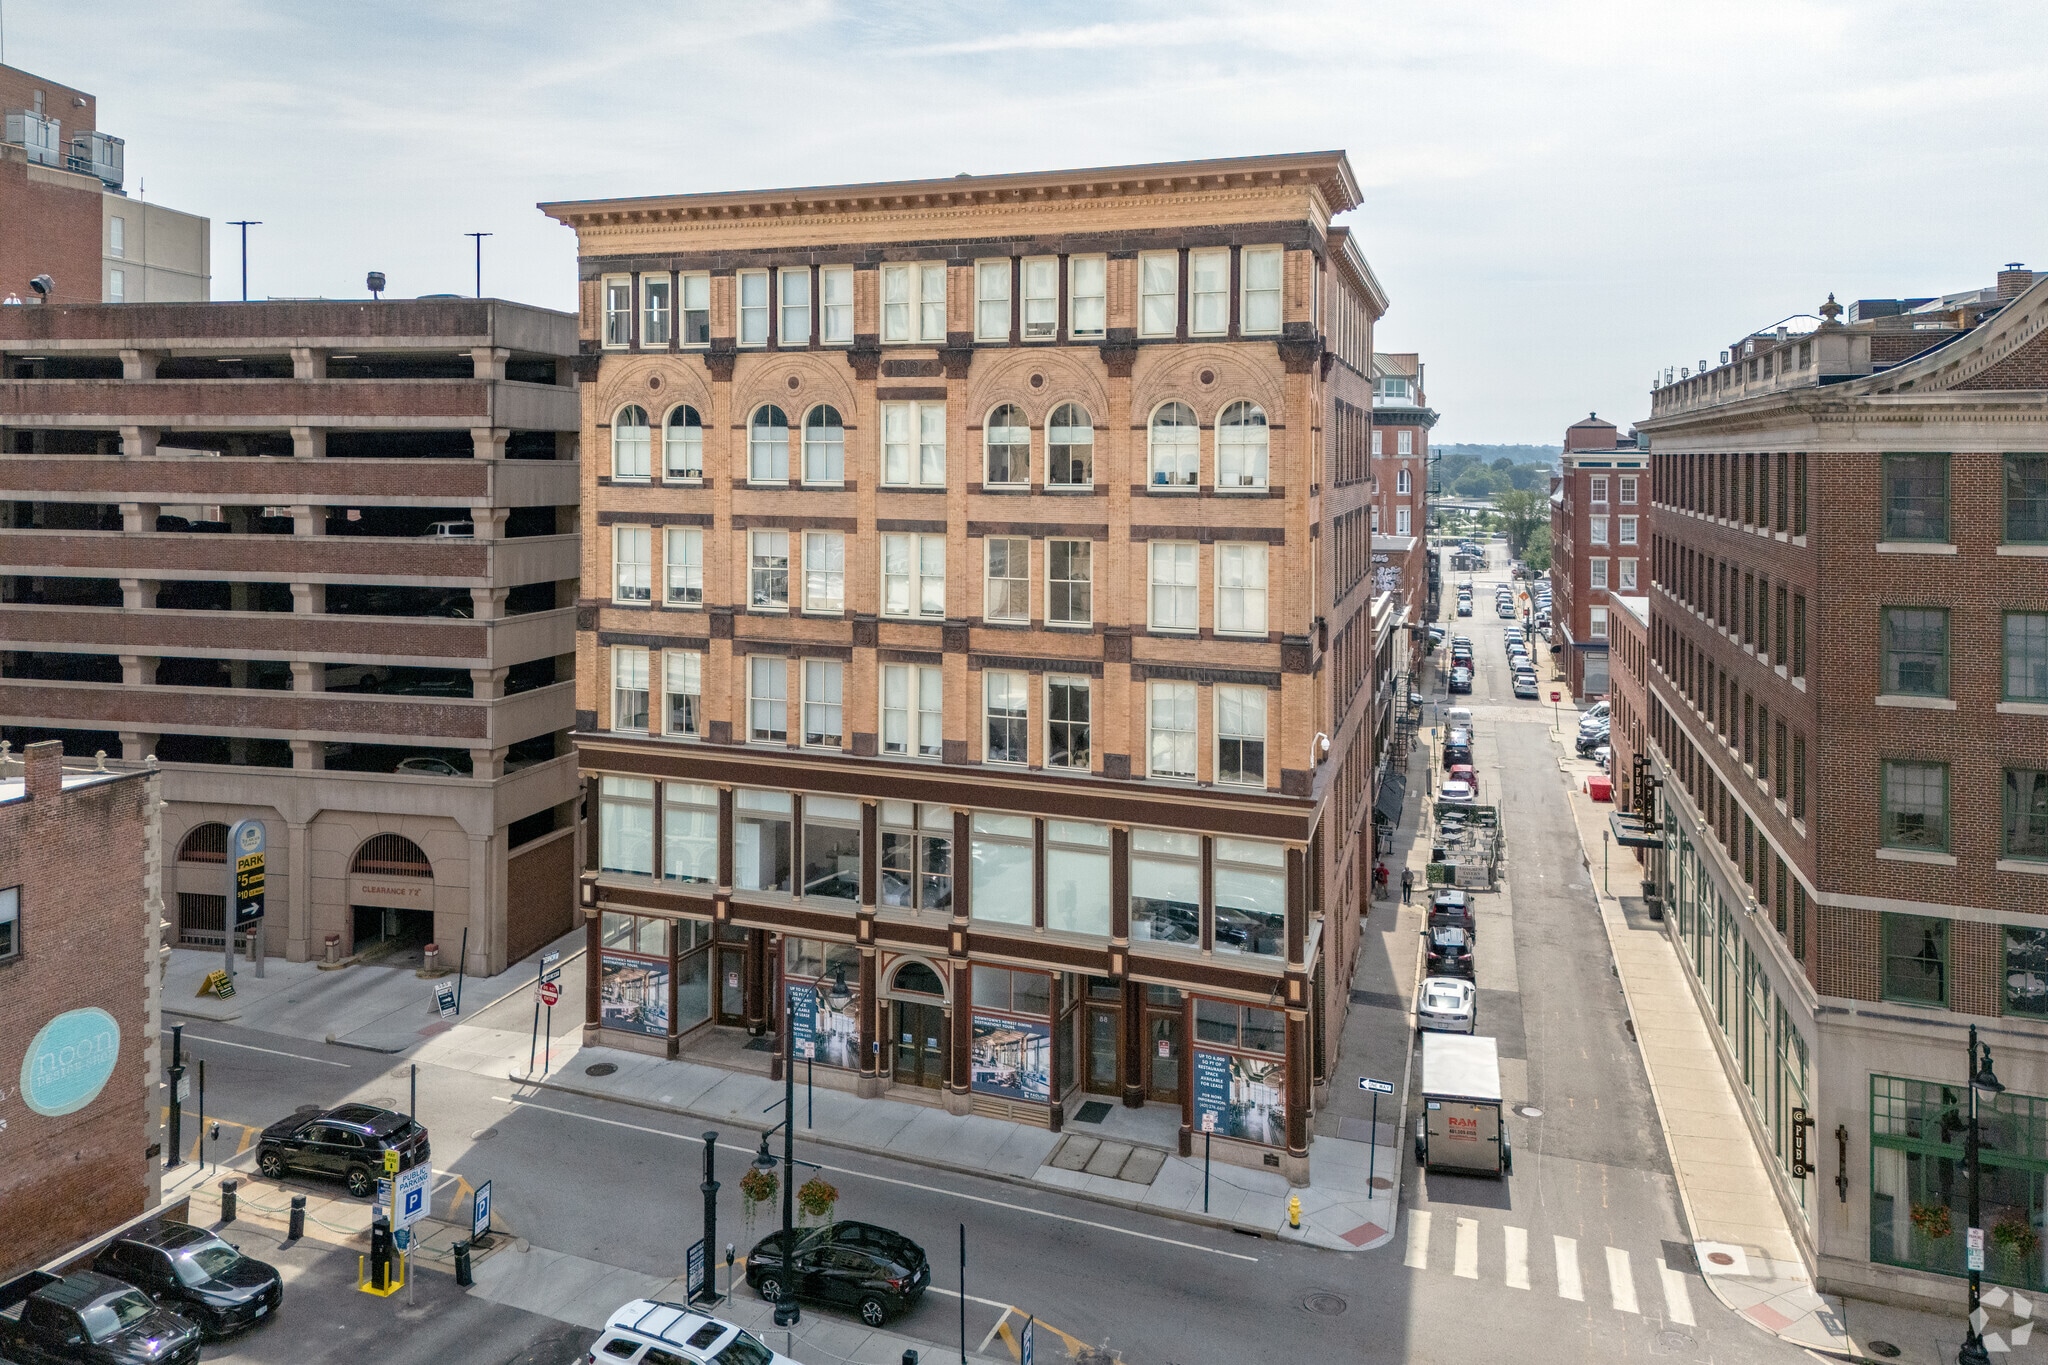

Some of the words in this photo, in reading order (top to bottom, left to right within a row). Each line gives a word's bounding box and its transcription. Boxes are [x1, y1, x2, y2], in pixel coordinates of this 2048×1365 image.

[238, 854, 264, 870] PARK
[238, 874, 249, 886] $5
[237, 890, 249, 899] $10
[362, 886, 406, 895] CLEARANCE
[974, 1016, 1001, 1024] DOWNTOWN'S
[38, 1031, 113, 1075] noon
[1198, 1065, 1226, 1073] RESTAURANT
[1449, 1117, 1477, 1127] RAM
[402, 1167, 426, 1183] PUBLIC
[400, 1173, 428, 1191] PARKING
[410, 1194, 418, 1209] P
[479, 1200, 485, 1219] P
